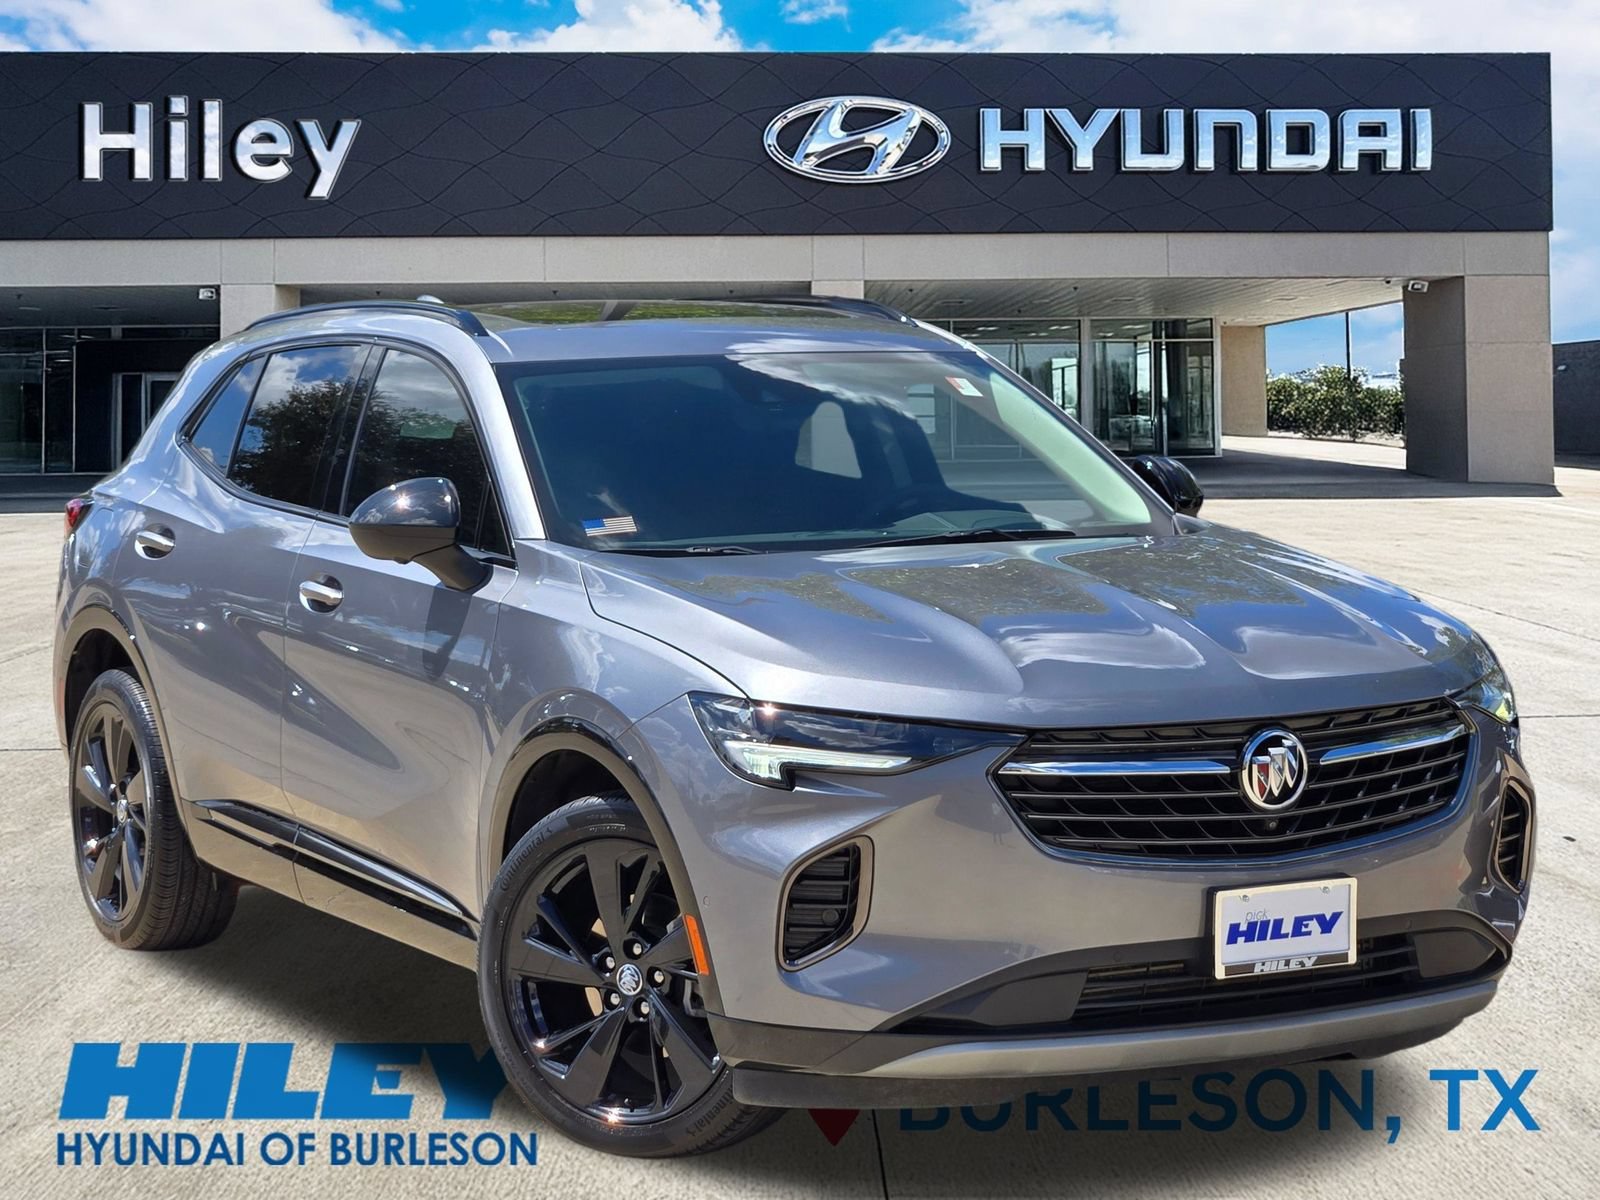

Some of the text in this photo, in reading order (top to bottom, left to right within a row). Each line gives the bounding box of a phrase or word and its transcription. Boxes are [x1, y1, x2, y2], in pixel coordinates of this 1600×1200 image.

[80, 95, 361, 199] Hiley
[980, 108, 1432, 171] HYUNDAI
[500, 831, 545, 892] Continental
[1226, 911, 1344, 945] HILEY
[1254, 956, 1318, 973] HILEY
